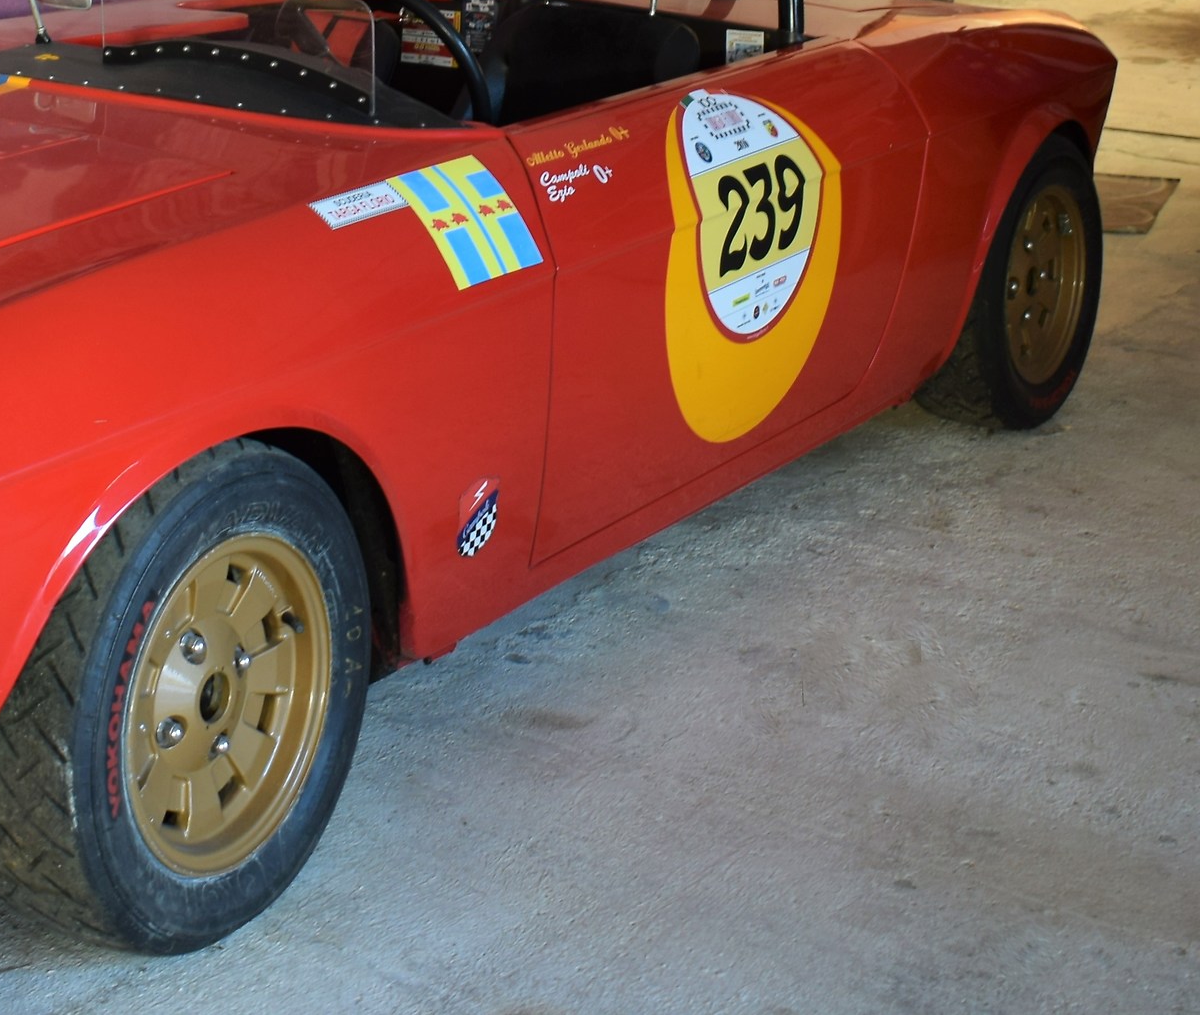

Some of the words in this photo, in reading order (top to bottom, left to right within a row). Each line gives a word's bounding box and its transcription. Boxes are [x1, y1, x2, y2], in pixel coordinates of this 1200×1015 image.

[540, 163, 591, 187] Campoli
[547, 185, 576, 203] Ezio
[717, 153, 807, 278] 239
[105, 600, 156, 819] YOKOHAMA
